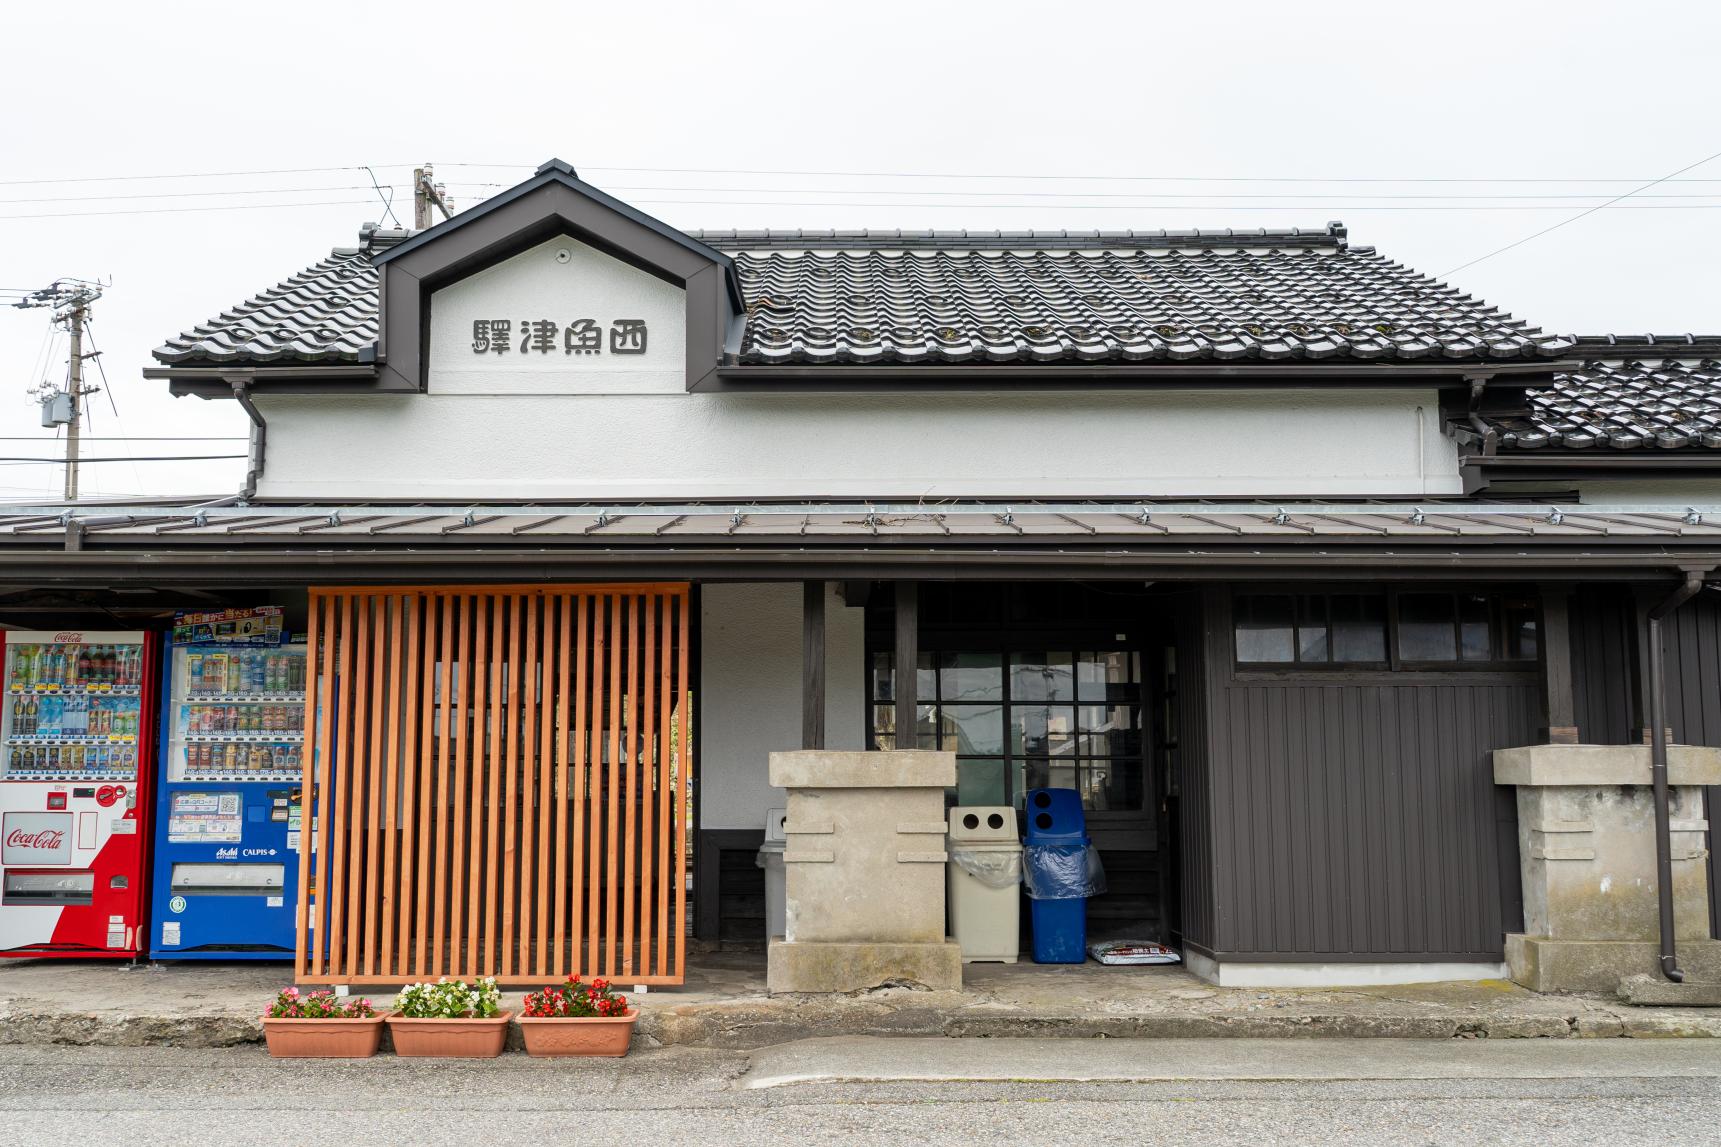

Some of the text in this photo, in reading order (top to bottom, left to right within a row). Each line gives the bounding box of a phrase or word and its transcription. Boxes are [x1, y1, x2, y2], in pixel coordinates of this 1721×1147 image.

[54, 631, 85, 643] Coca-Cola
[7, 829, 65, 849] Coca-Cola
[216, 847, 238, 856] Asahi
